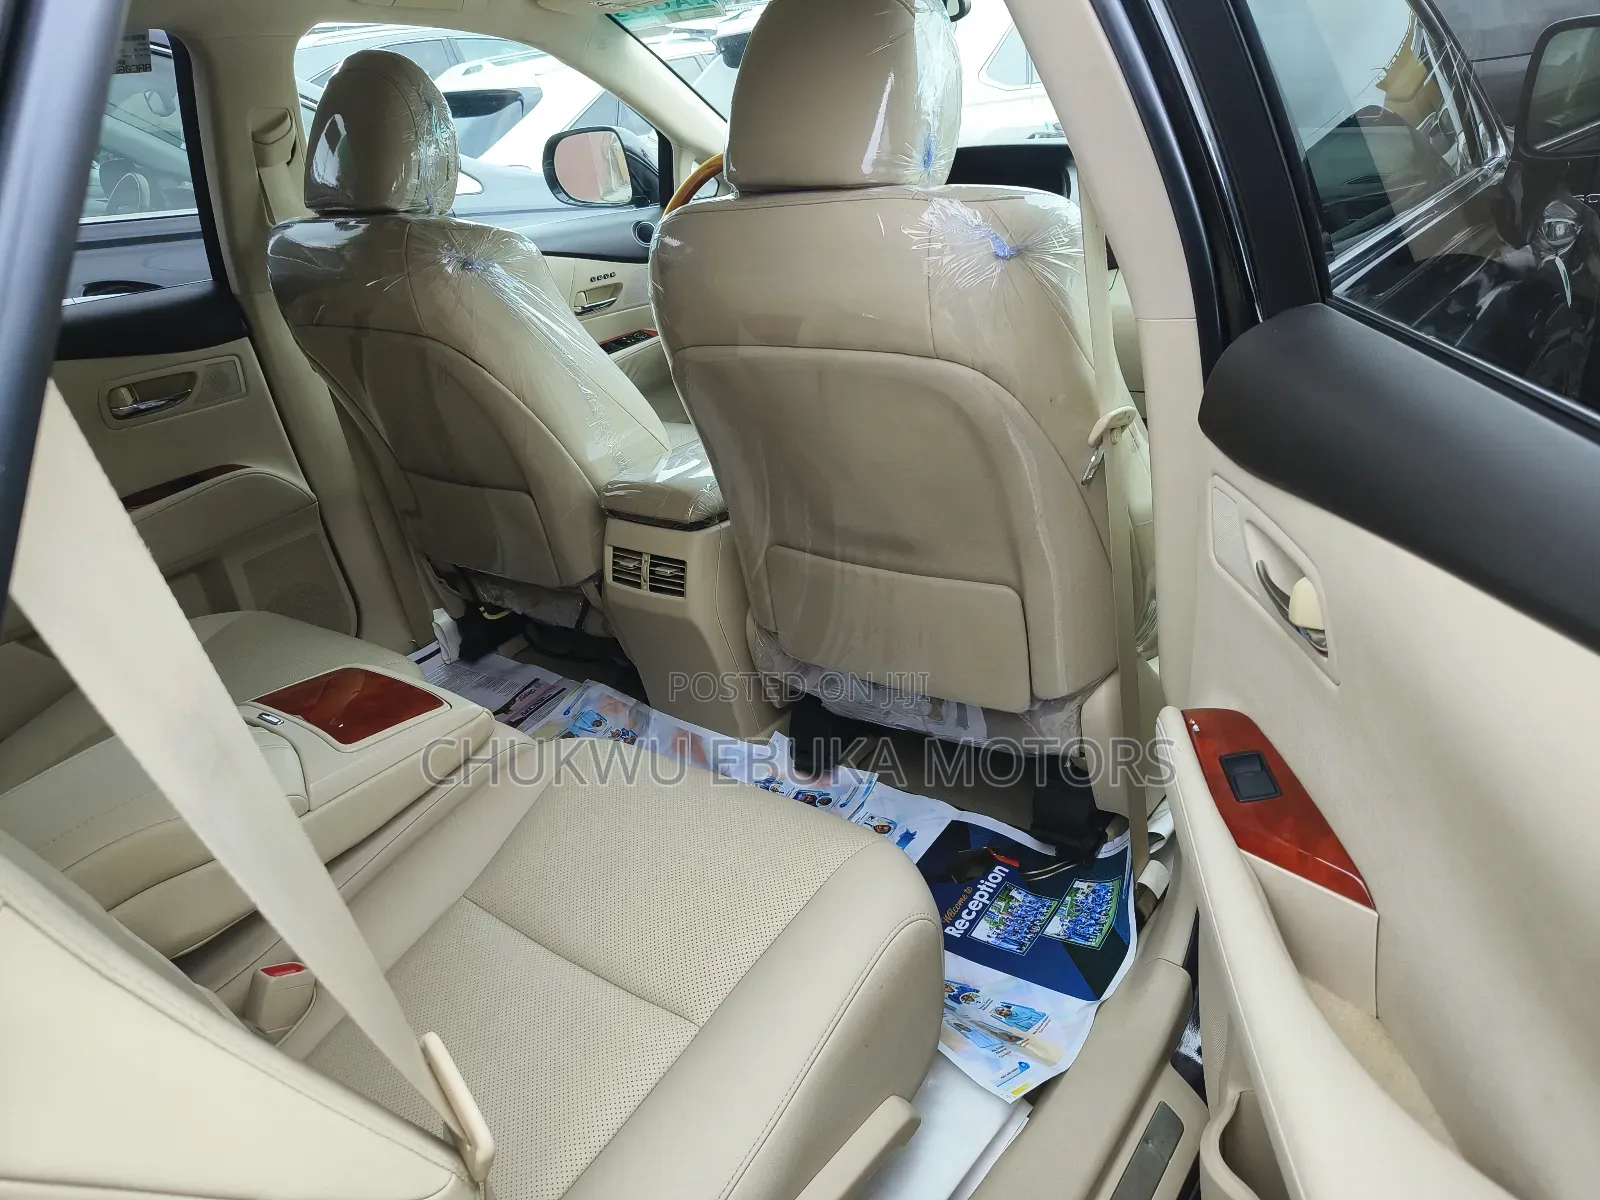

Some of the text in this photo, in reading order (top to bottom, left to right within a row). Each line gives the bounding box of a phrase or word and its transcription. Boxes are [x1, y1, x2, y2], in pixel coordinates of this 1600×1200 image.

[941, 886, 973, 924] Welcome to
[943, 865, 1010, 938] Reception
